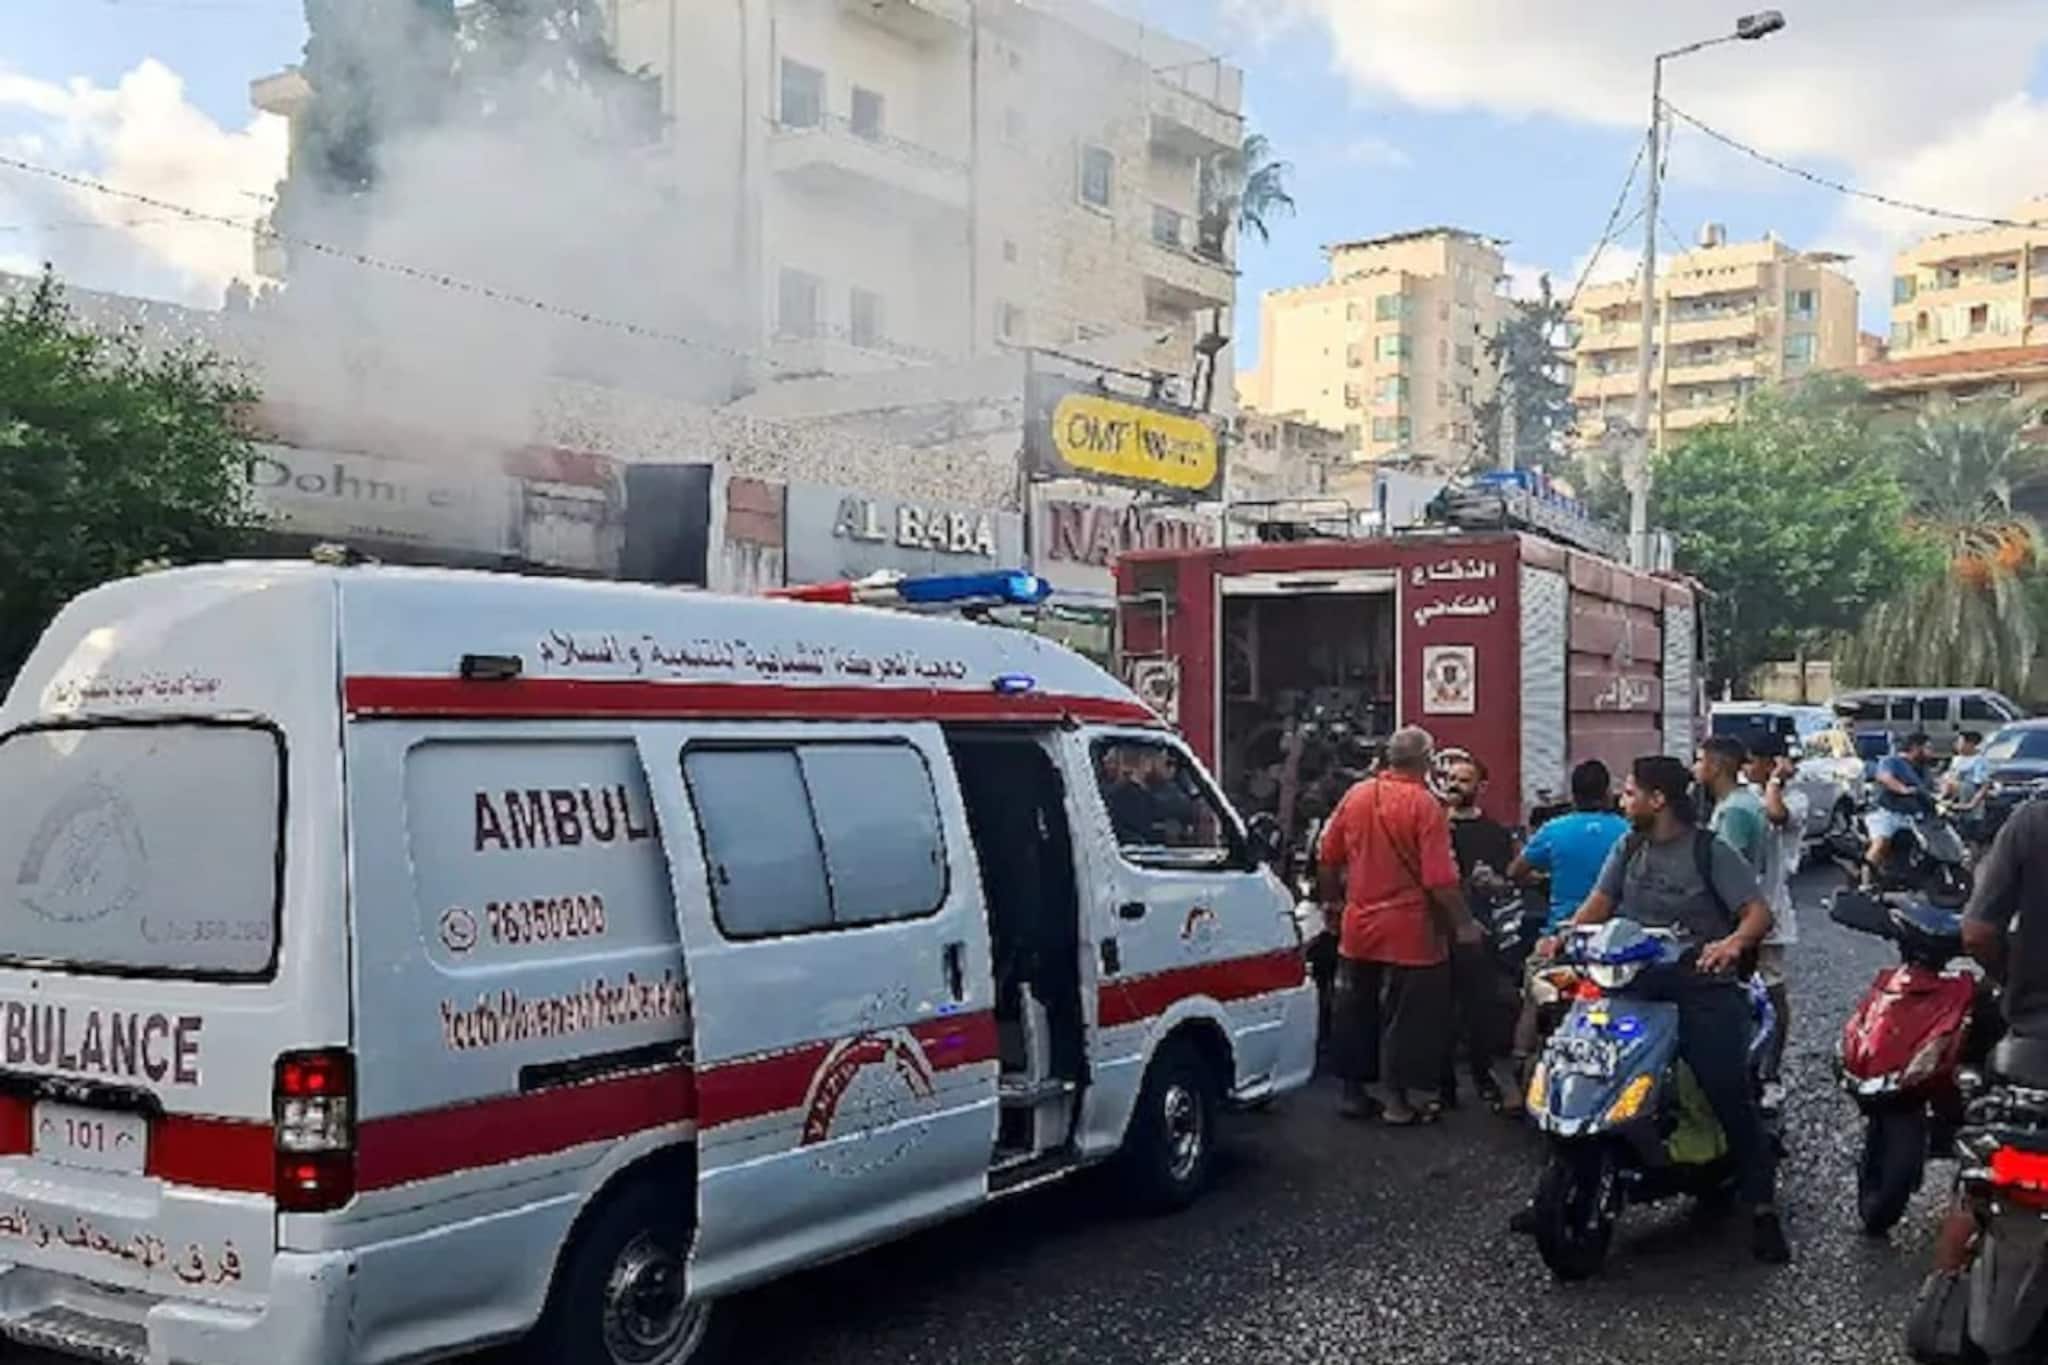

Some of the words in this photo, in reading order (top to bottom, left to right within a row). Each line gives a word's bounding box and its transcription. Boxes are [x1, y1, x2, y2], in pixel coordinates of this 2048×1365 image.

[1067, 412, 1131, 453] OMT
[833, 498, 885, 541] AL
[896, 503, 997, 557] BABA
[1410, 559, 1497, 587] الدفاع
[1413, 595, 1497, 627] المدني
[474, 783, 660, 851] AMBUL
[0, 1001, 203, 1086] BULANCE
[65, 1118, 105, 1152] 101
[172, 1238, 243, 1285] فرق
